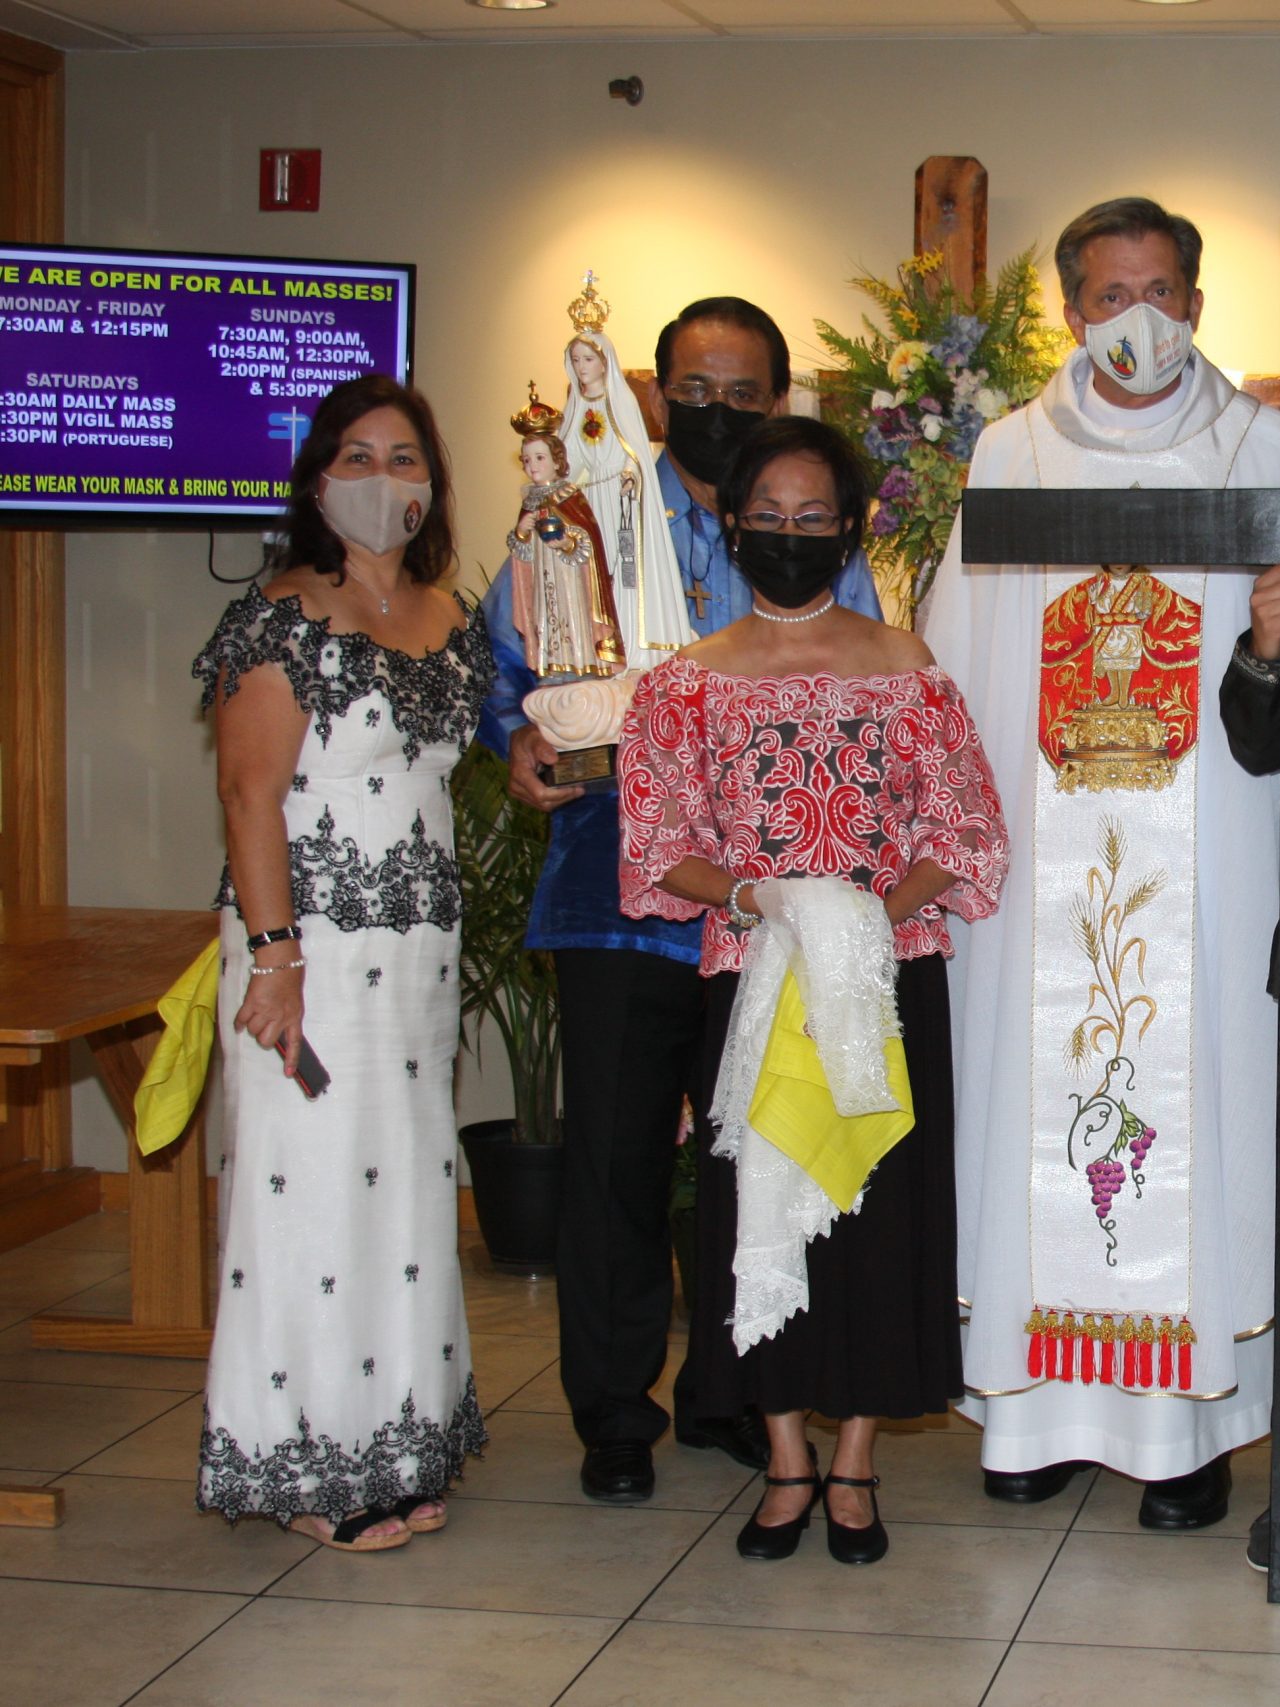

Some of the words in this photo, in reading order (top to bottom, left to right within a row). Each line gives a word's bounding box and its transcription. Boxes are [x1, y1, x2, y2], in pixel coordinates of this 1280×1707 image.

[0, 266, 20, 283] E
[28, 267, 82, 286] ARE
[90, 271, 161, 290] OPEN
[170, 275, 221, 293] FOR
[229, 278, 276, 296] ALL
[284, 280, 393, 302] MASSES!
[0, 296, 81, 313] MONDAY
[98, 301, 166, 318] FRIDAY
[250, 308, 336, 325] SUNDAYS
[70, 320, 84, 334] &
[91, 320, 169, 337] 12:15PM
[218, 326, 290, 346] 7:30AM,
[295, 330, 366, 349] 9:00AM,
[208, 344, 290, 364] 10:45AM,
[296, 348, 375, 367] 12:30PM,
[221, 362, 286, 379] 2:00PM
[26, 373, 139, 391] SATURDAYS
[250, 381, 263, 396] &
[269, 382, 333, 398] 5:30PM
[0, 392, 57, 408] :30AM
[63, 394, 118, 410] DAILY
[123, 396, 176, 411] MASS
[0, 411, 58, 426] :30PM
[63, 413, 115, 428] VIGIL
[120, 414, 174, 430] MASS
[0, 429, 57, 444] :30PM
[63, 432, 173, 450] (PORTUGUESE)
[0, 474, 31, 492] ASE
[35, 475, 77, 493] WEAR
[81, 476, 120, 494] YOUR
[124, 477, 164, 495] MASK
[169, 478, 179, 496] &
[183, 479, 227, 496] BRING
[231, 480, 269, 497] YOUR
